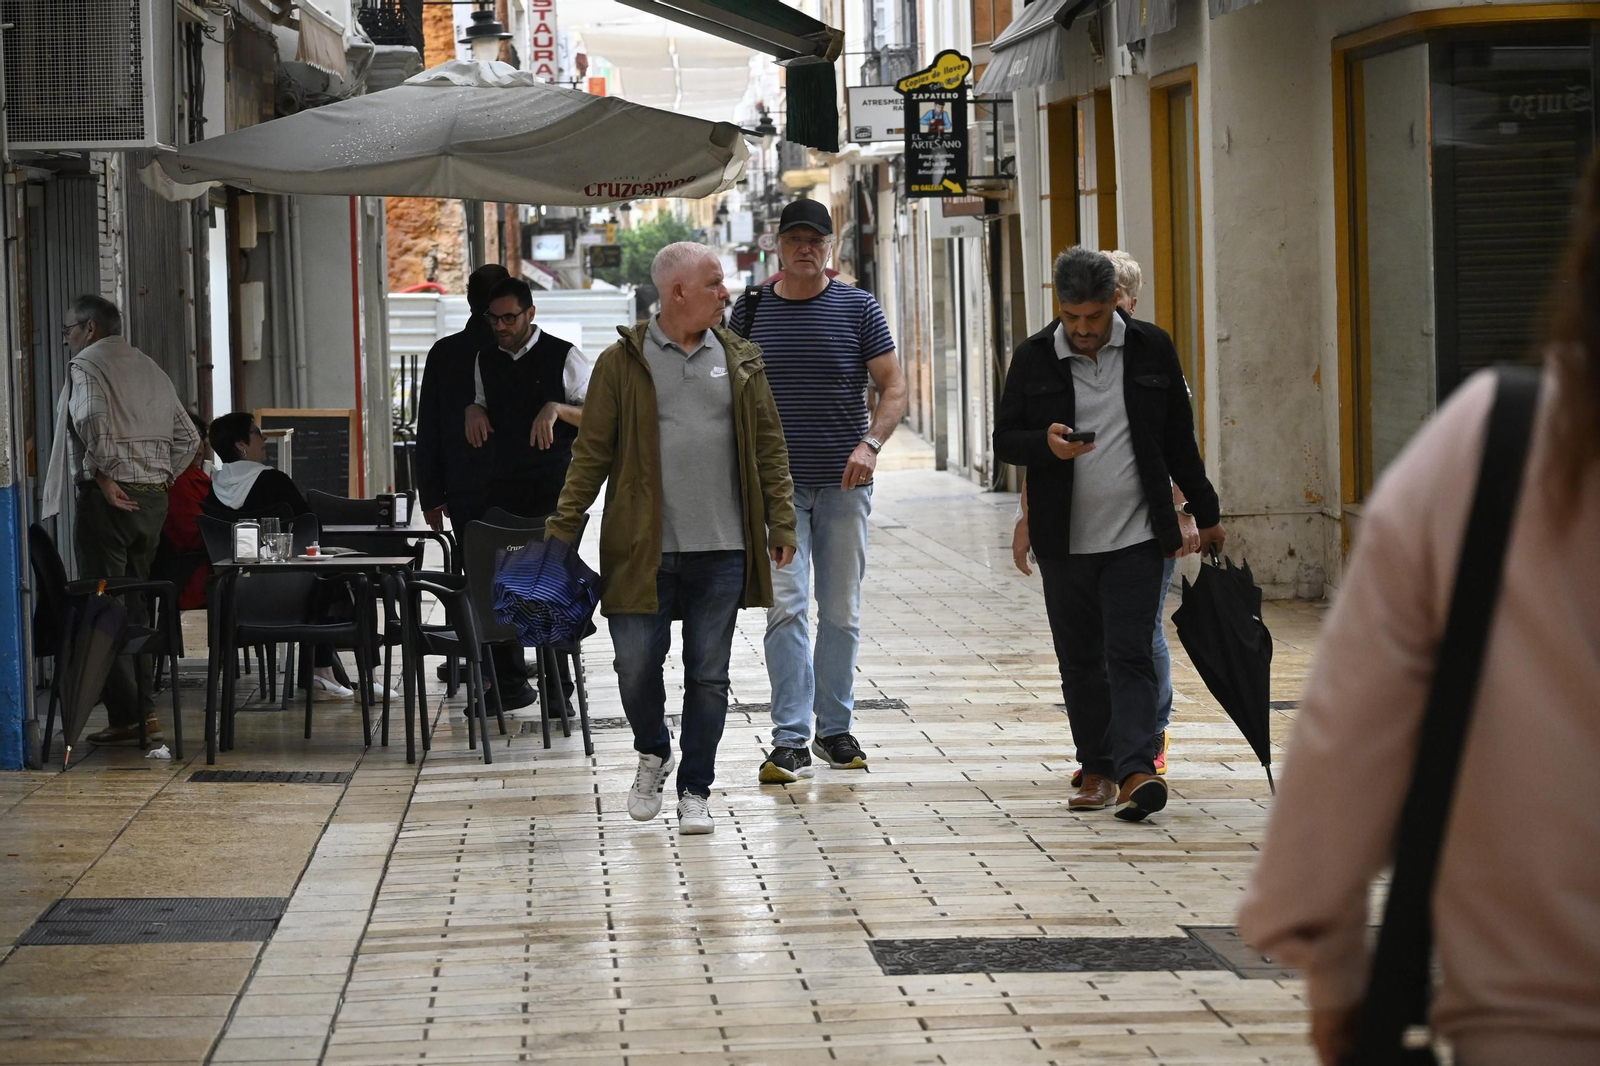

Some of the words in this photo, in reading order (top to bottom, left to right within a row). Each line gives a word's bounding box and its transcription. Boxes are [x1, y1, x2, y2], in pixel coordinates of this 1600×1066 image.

[533, 0, 554, 84] STAURA
[931, 70, 940, 78] de
[912, 92, 959, 100] ZAPATERO
